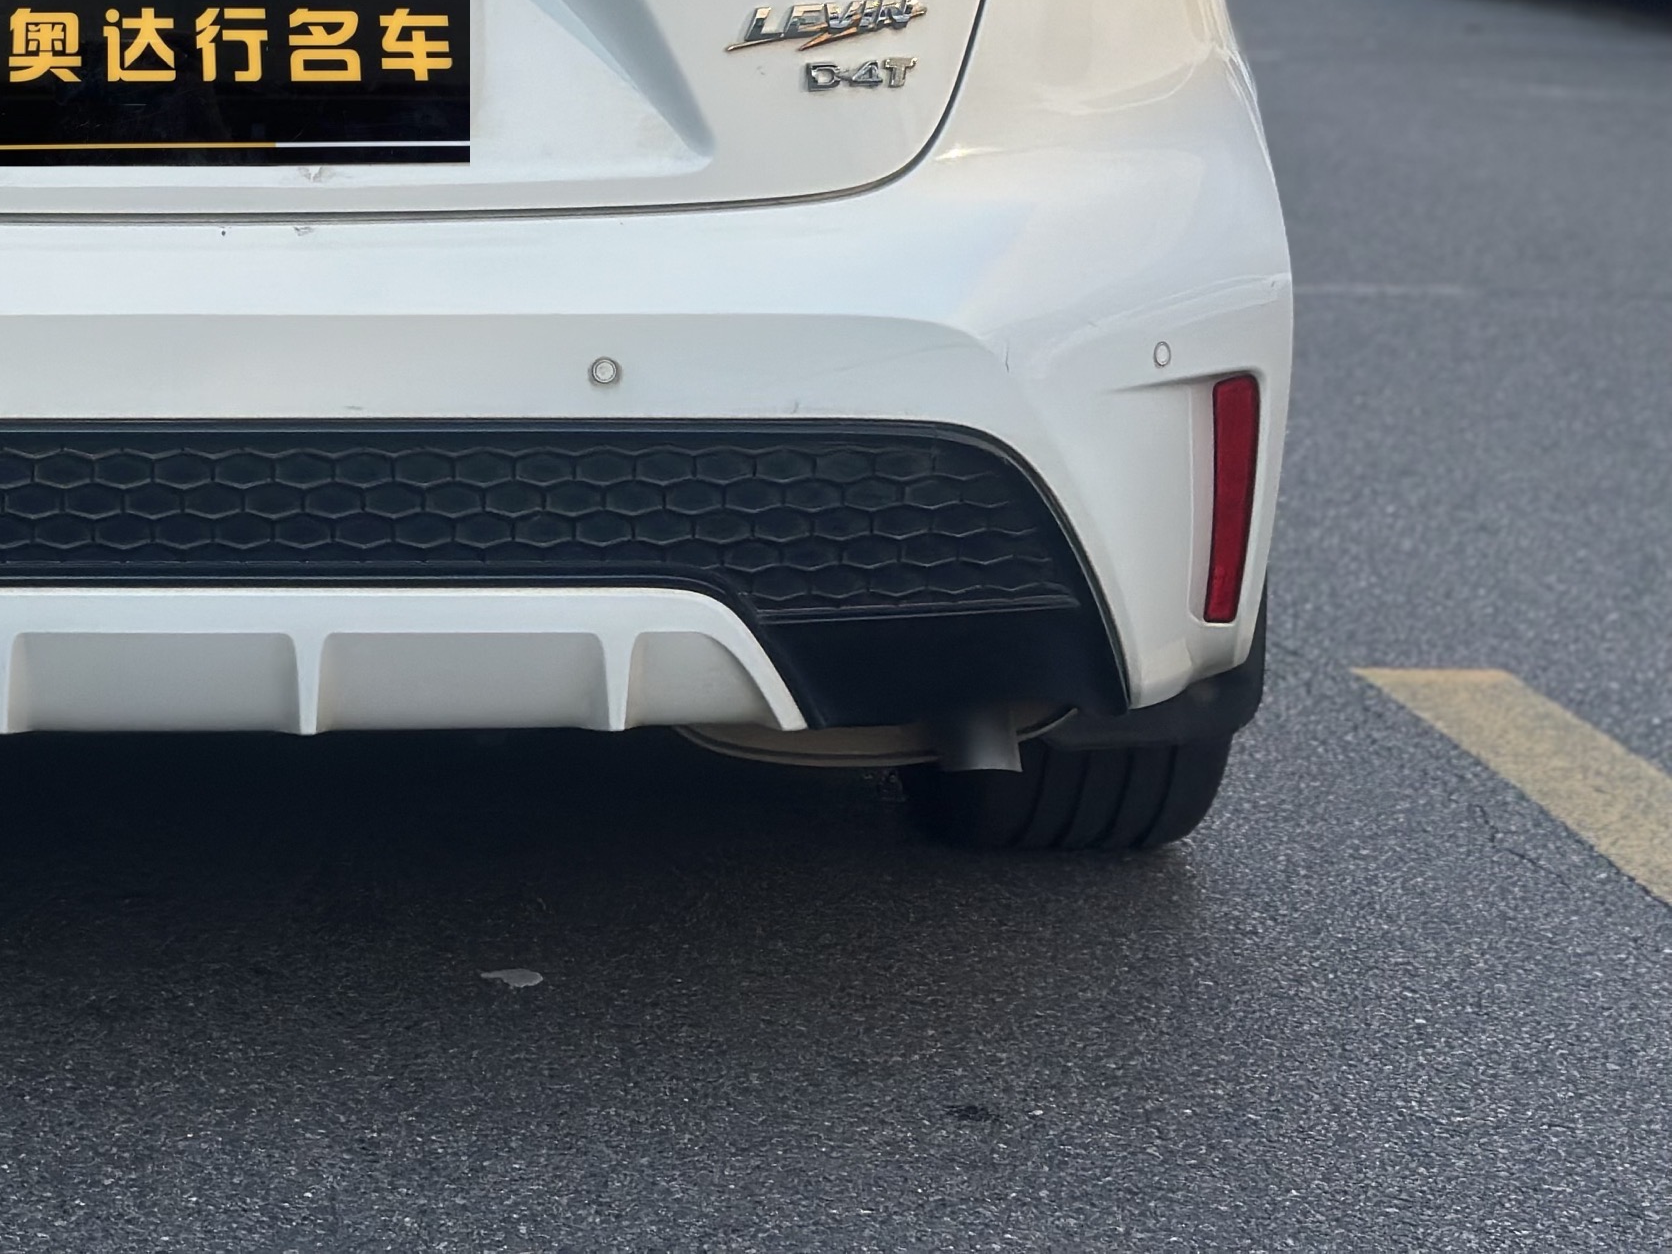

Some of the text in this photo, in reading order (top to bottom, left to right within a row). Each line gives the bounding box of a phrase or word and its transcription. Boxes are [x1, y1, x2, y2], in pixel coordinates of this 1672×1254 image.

[8, 7, 453, 83] 奥达行名车
[805, 56, 918, 92] D-4T
